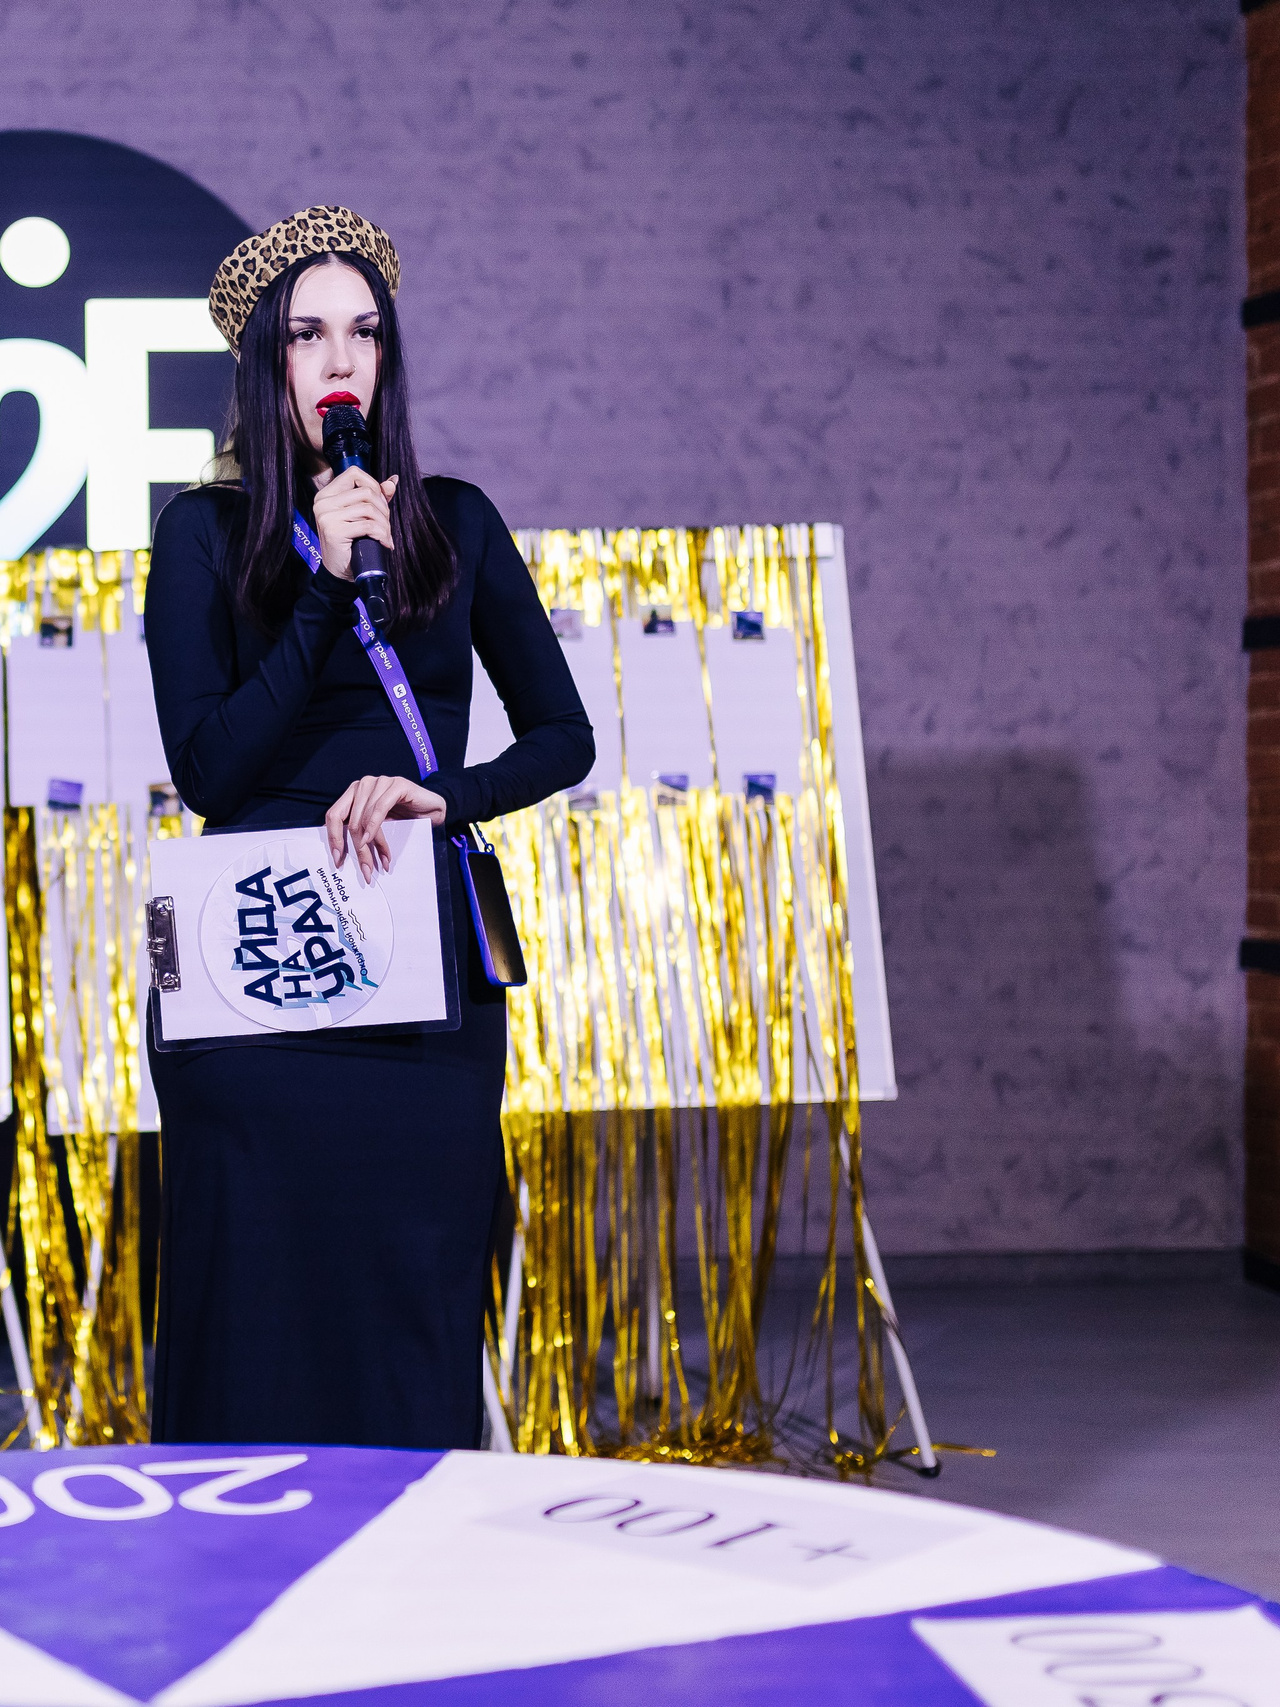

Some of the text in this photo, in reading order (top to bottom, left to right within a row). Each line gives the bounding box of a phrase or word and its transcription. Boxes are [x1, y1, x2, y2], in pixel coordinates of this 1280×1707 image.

[401, 698, 432, 772] место встречи
[316, 867, 350, 932] туристический
[331, 872, 350, 903] форум
[234, 865, 283, 1007] АЙДА
[273, 868, 355, 1000] УРАЛ
[281, 949, 312, 1000] НА
